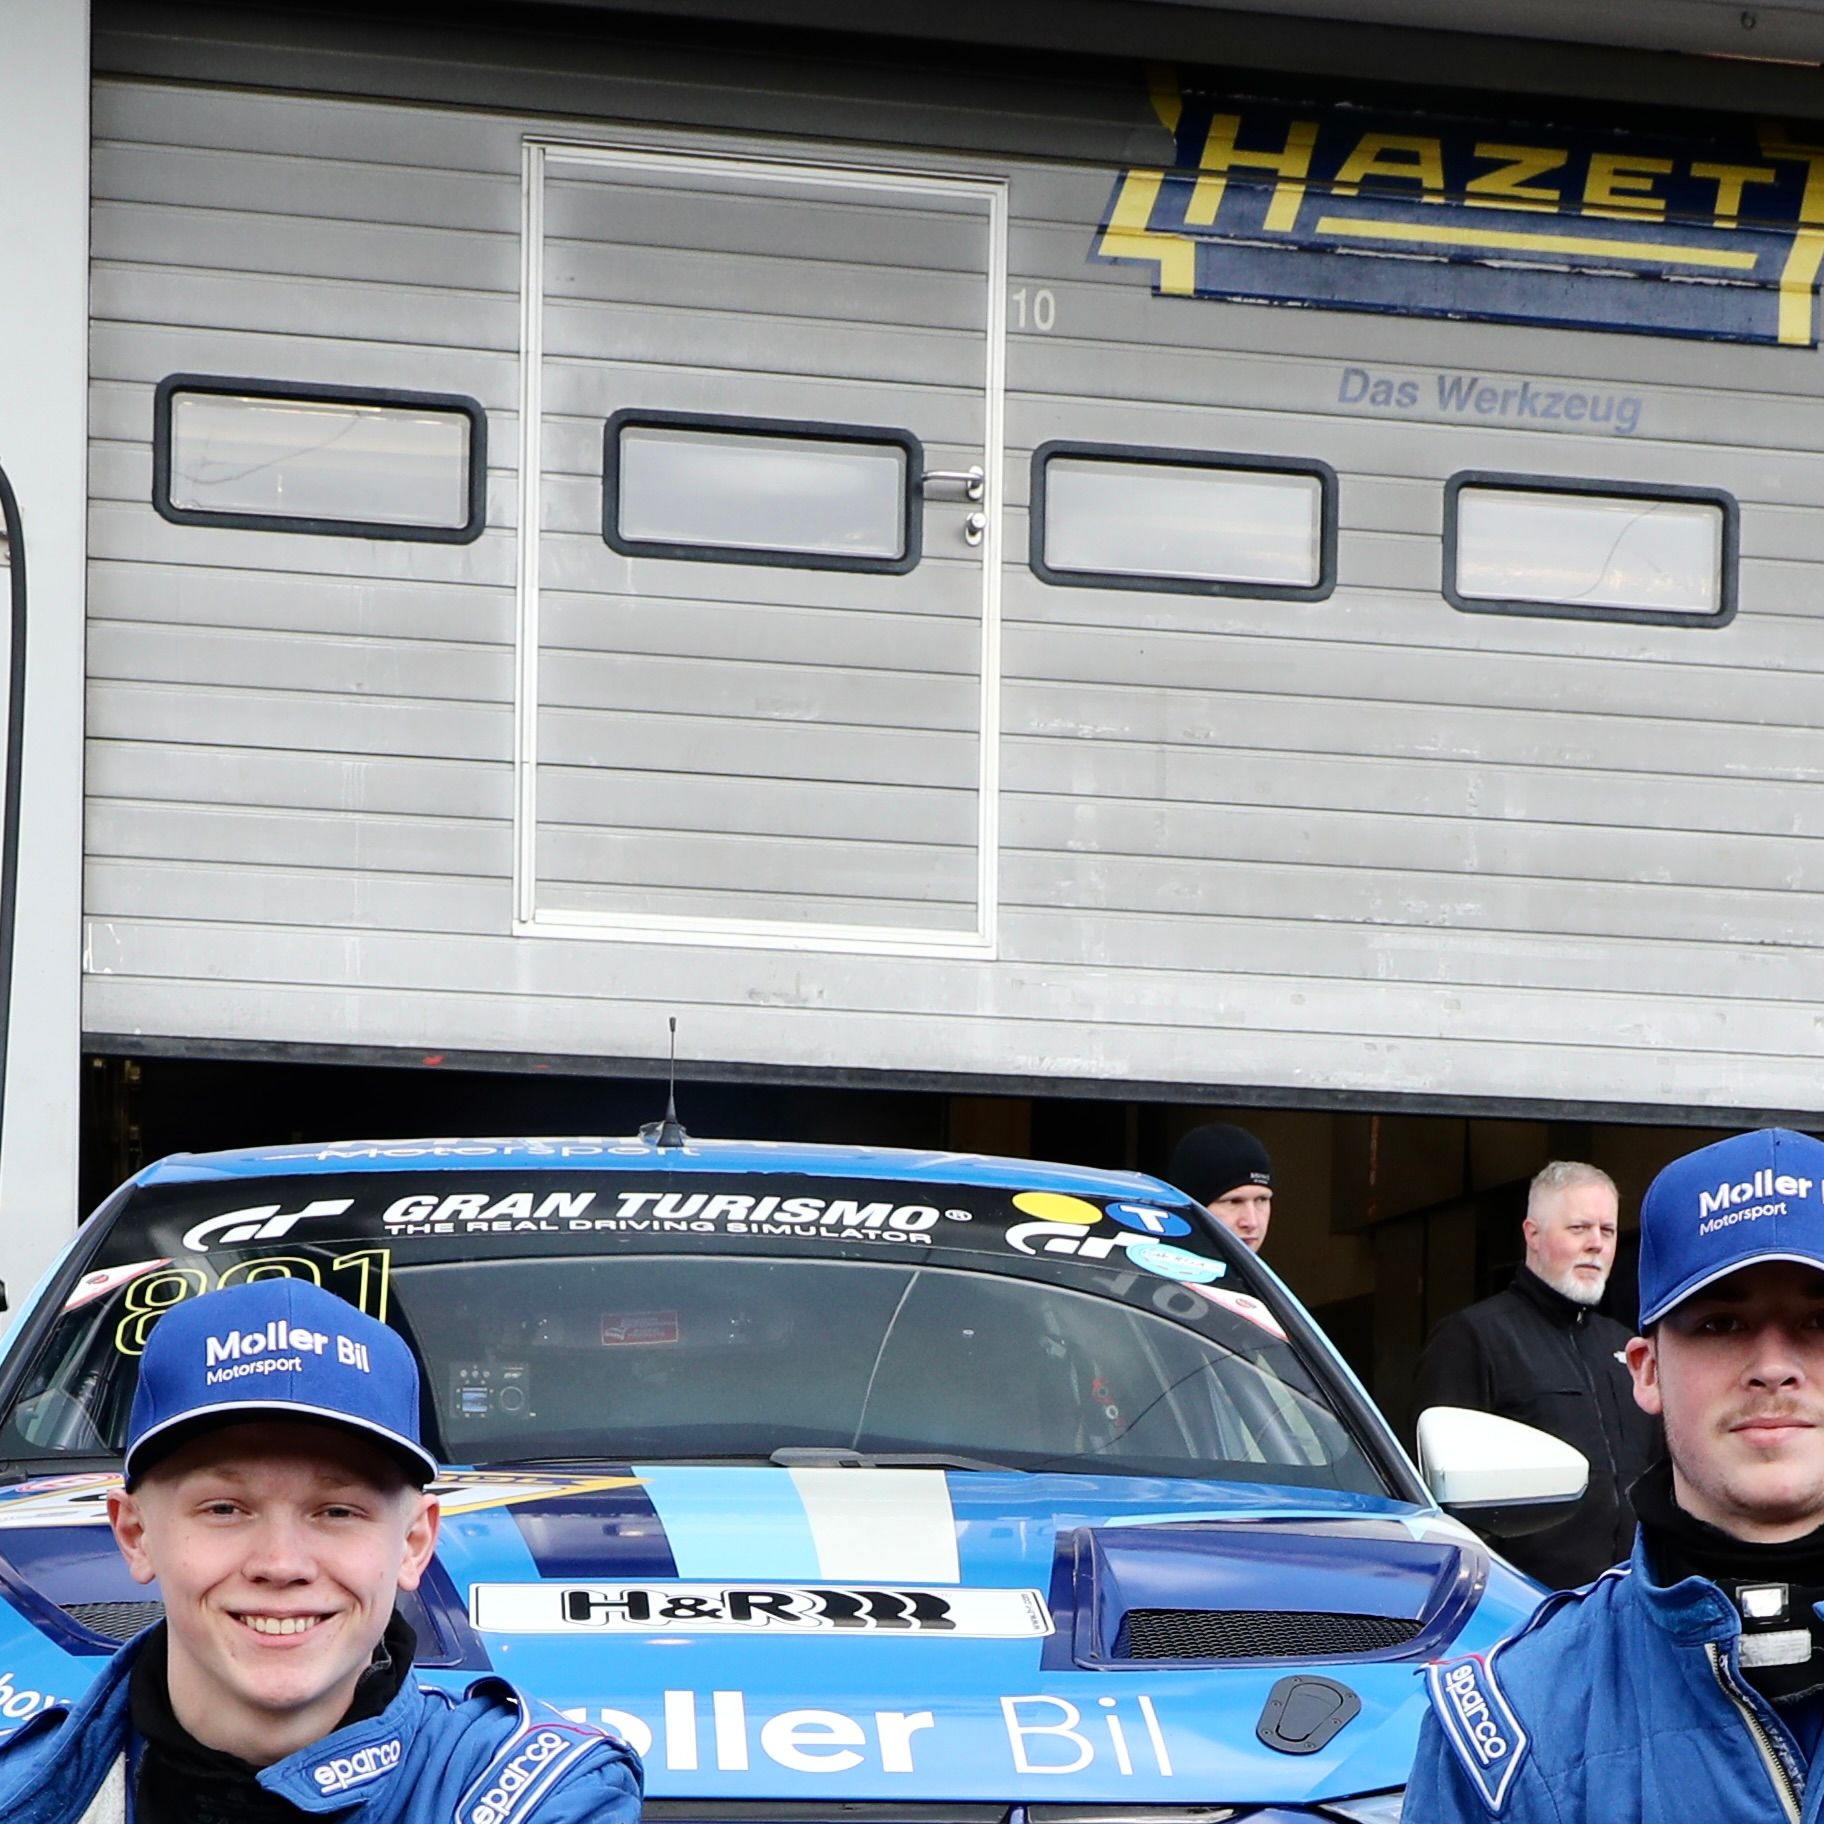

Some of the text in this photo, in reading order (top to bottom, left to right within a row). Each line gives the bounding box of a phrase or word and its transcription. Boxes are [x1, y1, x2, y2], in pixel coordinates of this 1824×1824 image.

[1185, 113, 1777, 234] HAZET
[1011, 288, 1056, 334] 10
[1337, 367, 1643, 433] Das Werkzeug
[381, 1191, 597, 1225] GRAN
[1698, 1201, 1788, 1236] Motorsport
[384, 1218, 934, 1245] THE REAL DRIVING SIMULATOR
[206, 1356, 303, 1386] Motorsport
[335, 1334, 371, 1374] Bil
[566, 1588, 806, 1630] H&R
[999, 1695, 1174, 1778] Bil
